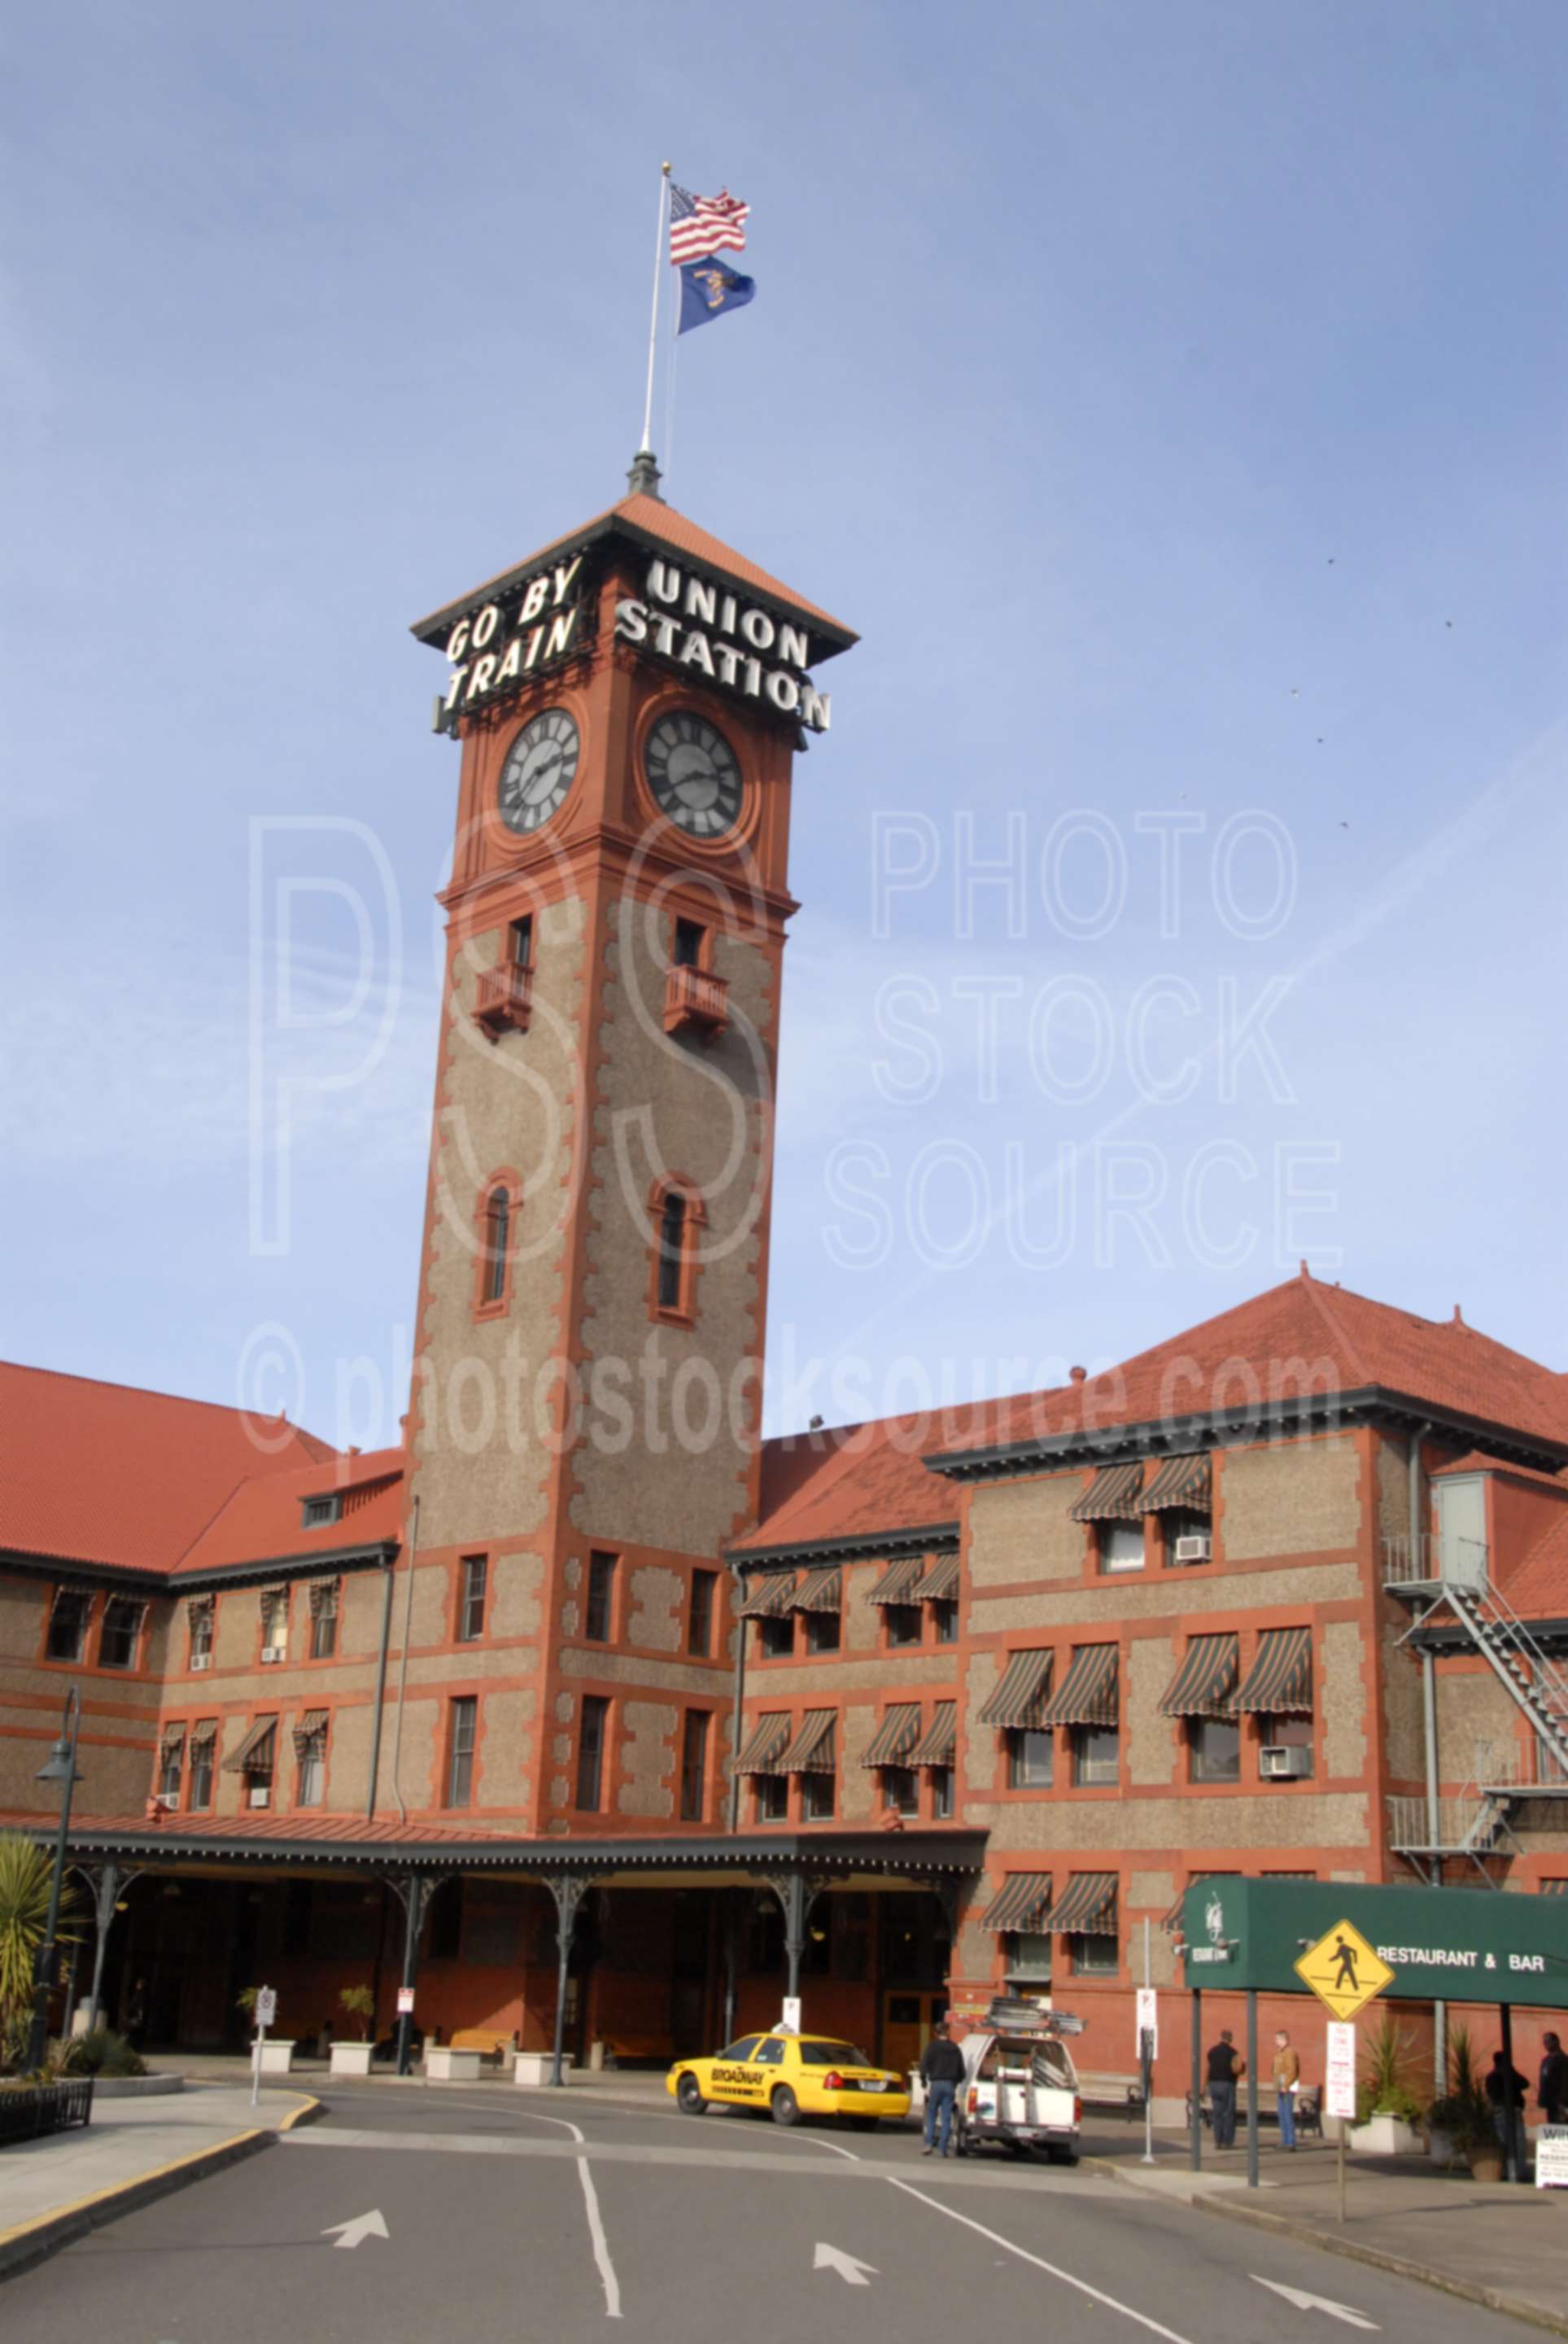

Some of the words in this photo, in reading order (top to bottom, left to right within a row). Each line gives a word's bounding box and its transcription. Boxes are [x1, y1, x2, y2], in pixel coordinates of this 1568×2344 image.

[443, 608, 576, 711] TRAIN
[447, 606, 498, 663] GO
[518, 556, 583, 624] BY
[647, 559, 808, 669] UNION
[614, 598, 830, 731] STATION
[1378, 1946, 1478, 1967] RESTAURANT
[1484, 1953, 1496, 1969] &
[1509, 1954, 1544, 1972] BAR
[711, 2068, 765, 2085] BROADWAY
